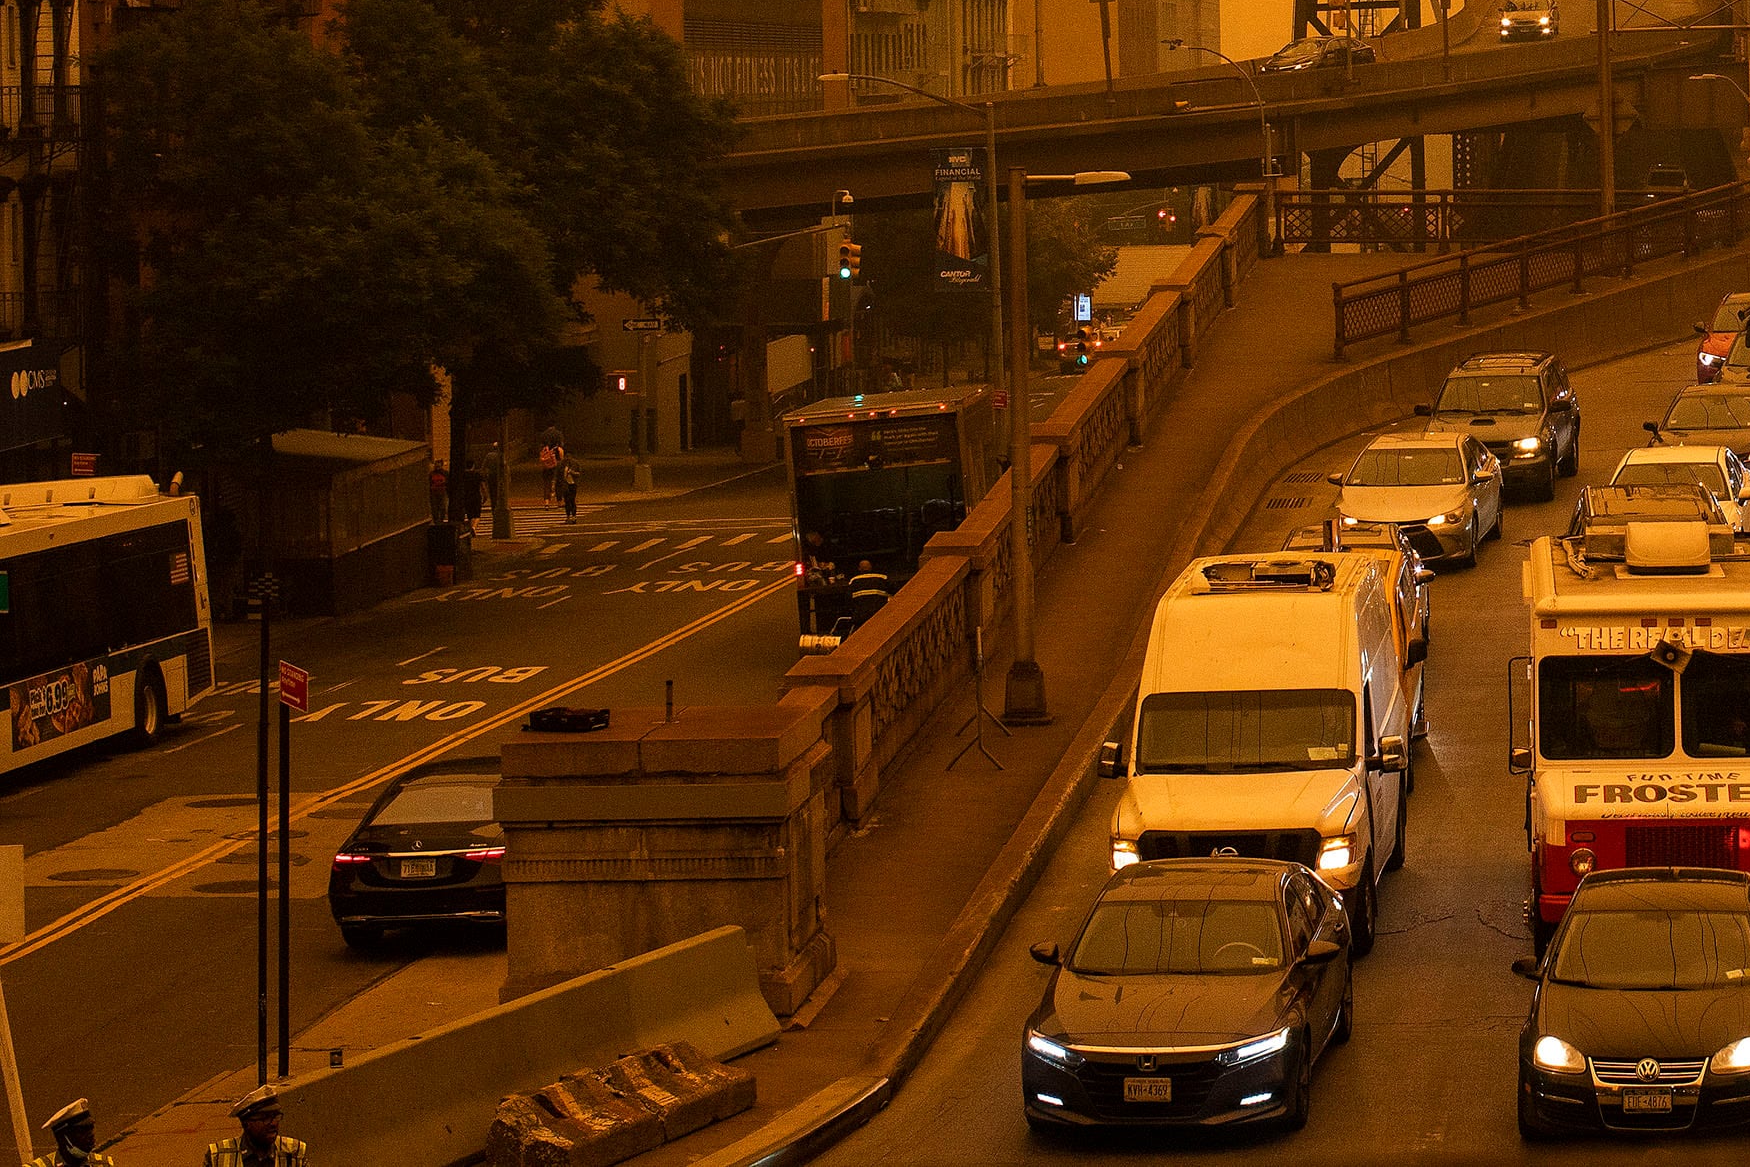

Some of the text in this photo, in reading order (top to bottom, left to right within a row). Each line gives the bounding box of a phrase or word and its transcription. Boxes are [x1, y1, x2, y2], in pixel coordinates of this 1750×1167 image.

[934, 167, 981, 176] FINANCIAL
[940, 270, 971, 278] CANTOR
[401, 665, 550, 685] BUS
